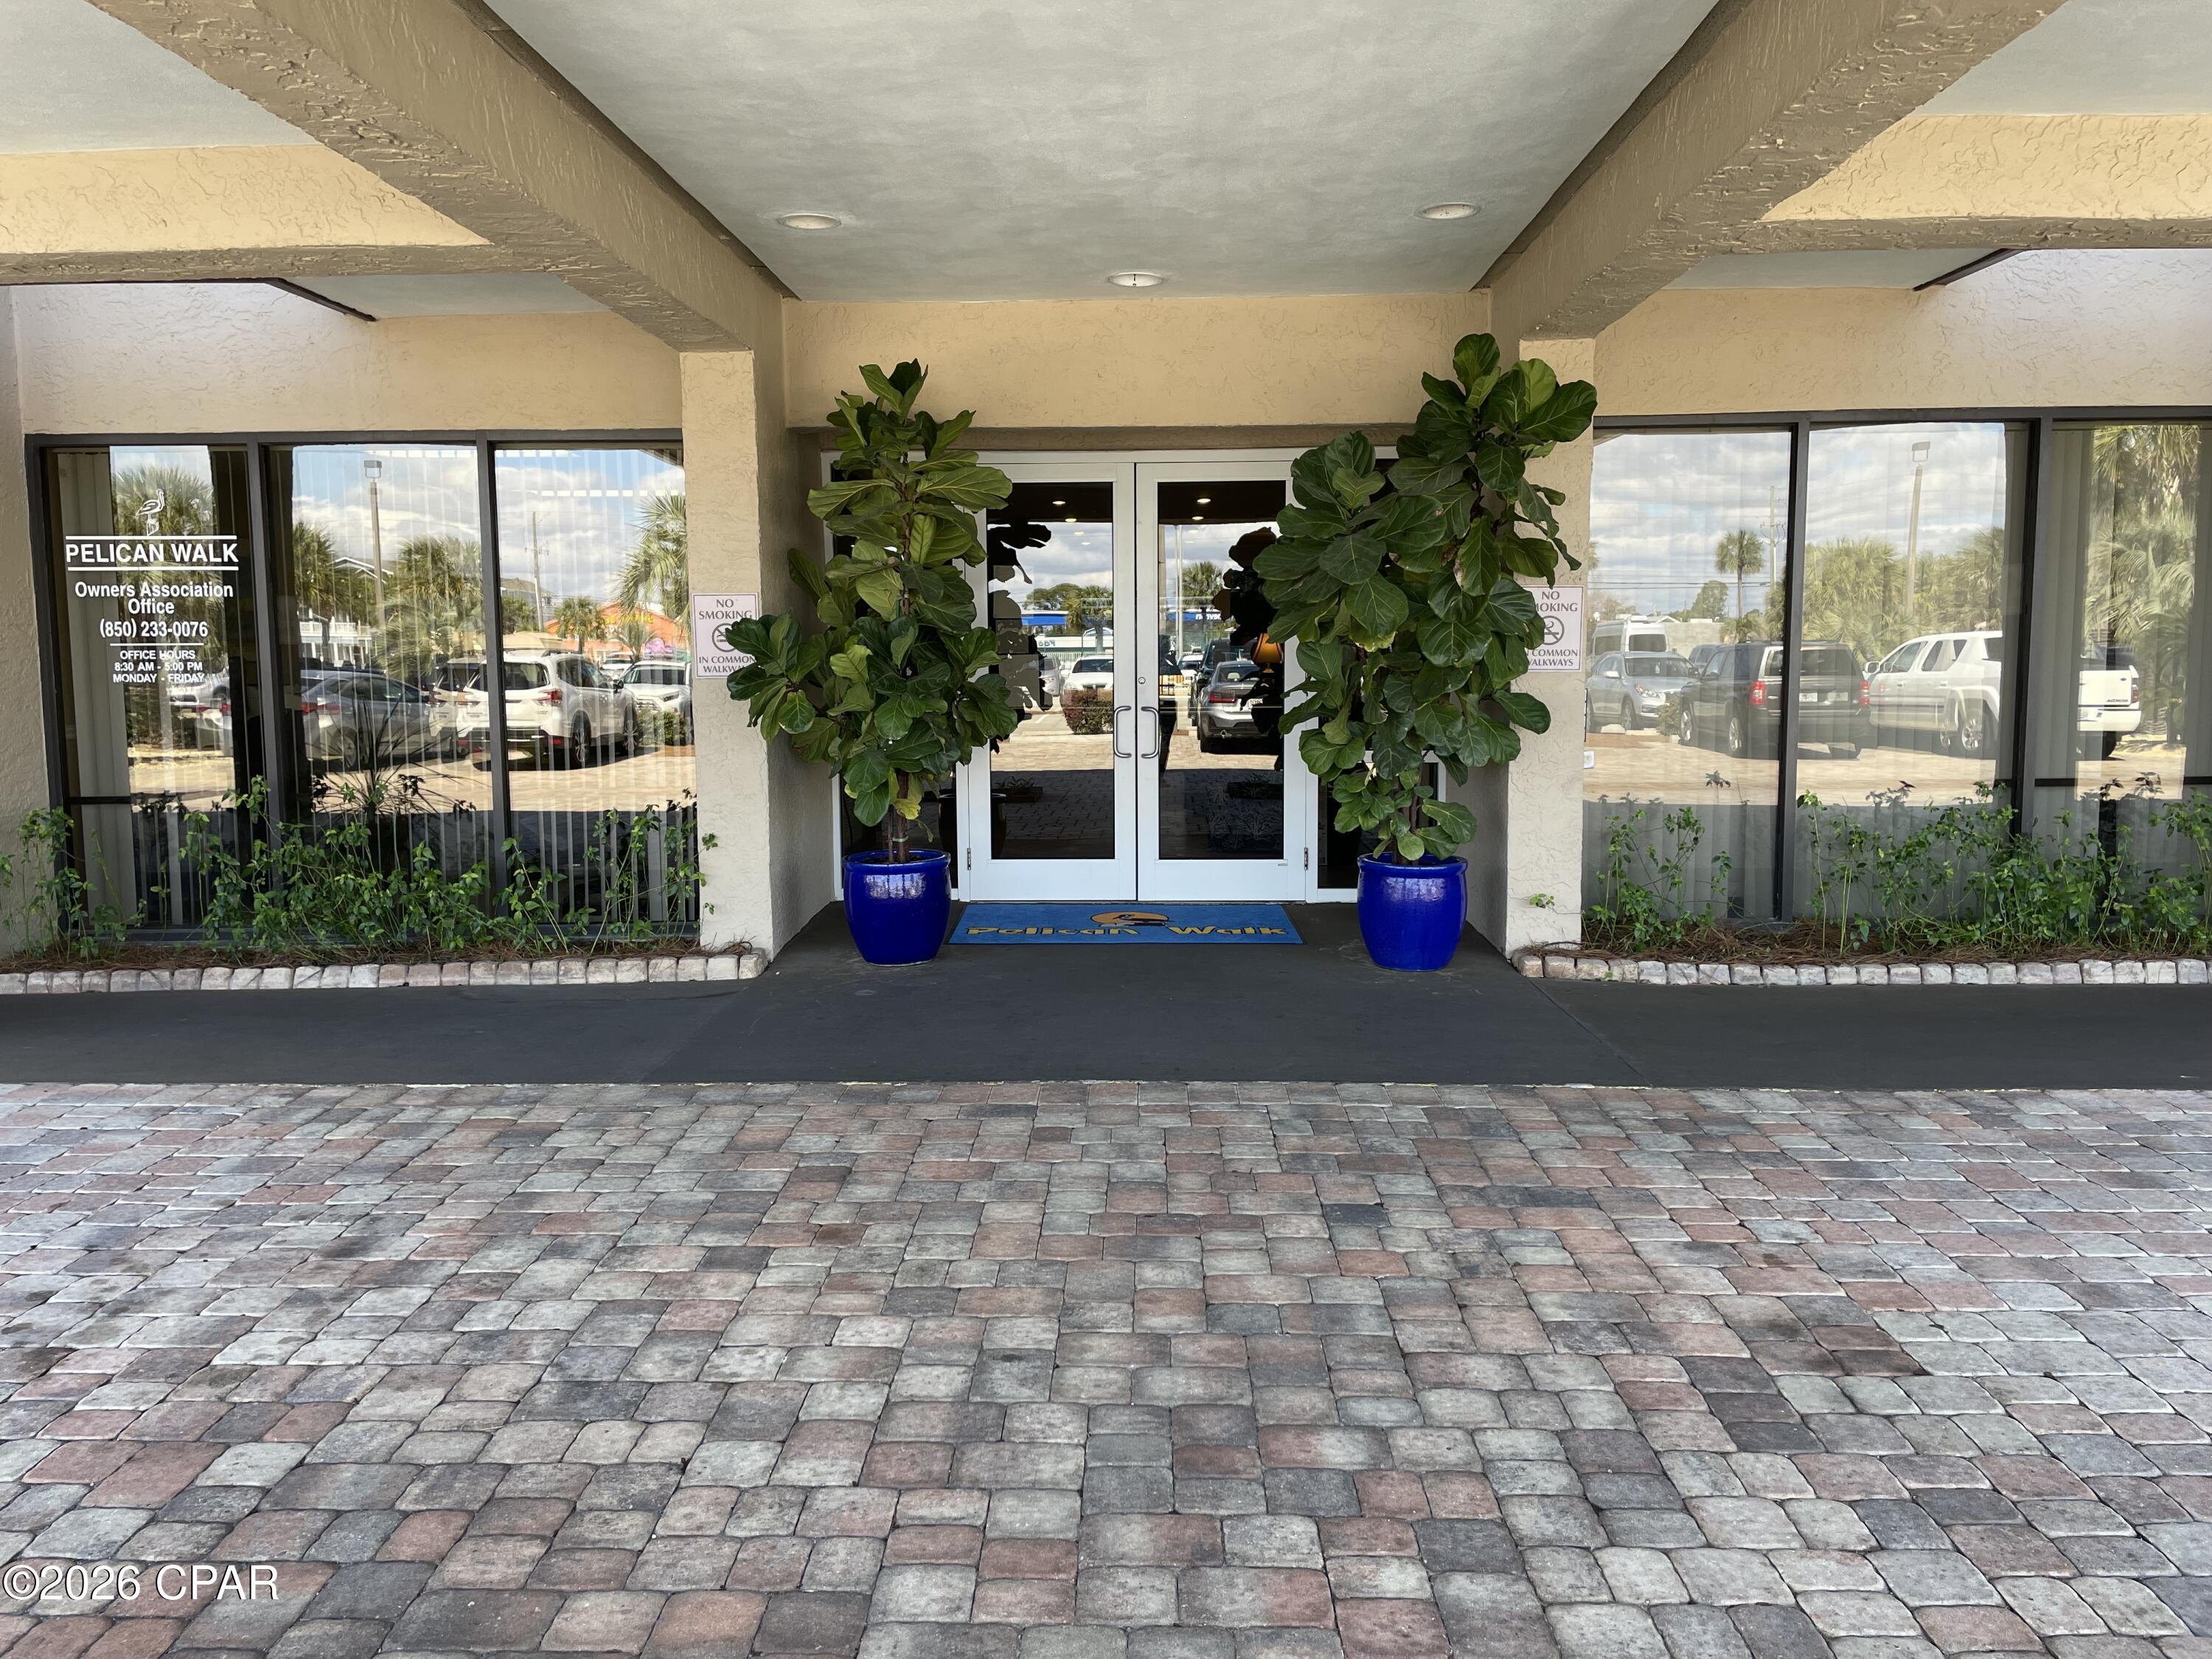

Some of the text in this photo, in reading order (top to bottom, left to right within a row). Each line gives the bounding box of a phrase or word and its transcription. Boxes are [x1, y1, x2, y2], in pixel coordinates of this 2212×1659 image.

[66, 543, 239, 563] PELICAN WALK
[75, 581, 234, 597] Owners Association
[1542, 591, 1560, 600] NO
[128, 598, 175, 614] Office
[716, 599, 734, 608] NO
[1536, 602, 1578, 612] OKING
[698, 610, 753, 620] SMOKING
[100, 618, 209, 638] (850) 233-0076
[119, 650, 196, 660] OFFICE HOURS
[1531, 649, 1578, 657] COMMON
[698, 655, 756, 664] IN COMMON
[114, 661, 134, 671] 8:30
[137, 661, 154, 671] AM
[164, 661, 184, 671] 5:00
[187, 661, 203, 671] PM
[703, 665, 745, 673] WALKW
[113, 673, 157, 683] MONDAY
[167, 673, 204, 683] FRIDAY
[966, 925, 1289, 936] Pelican Walk
